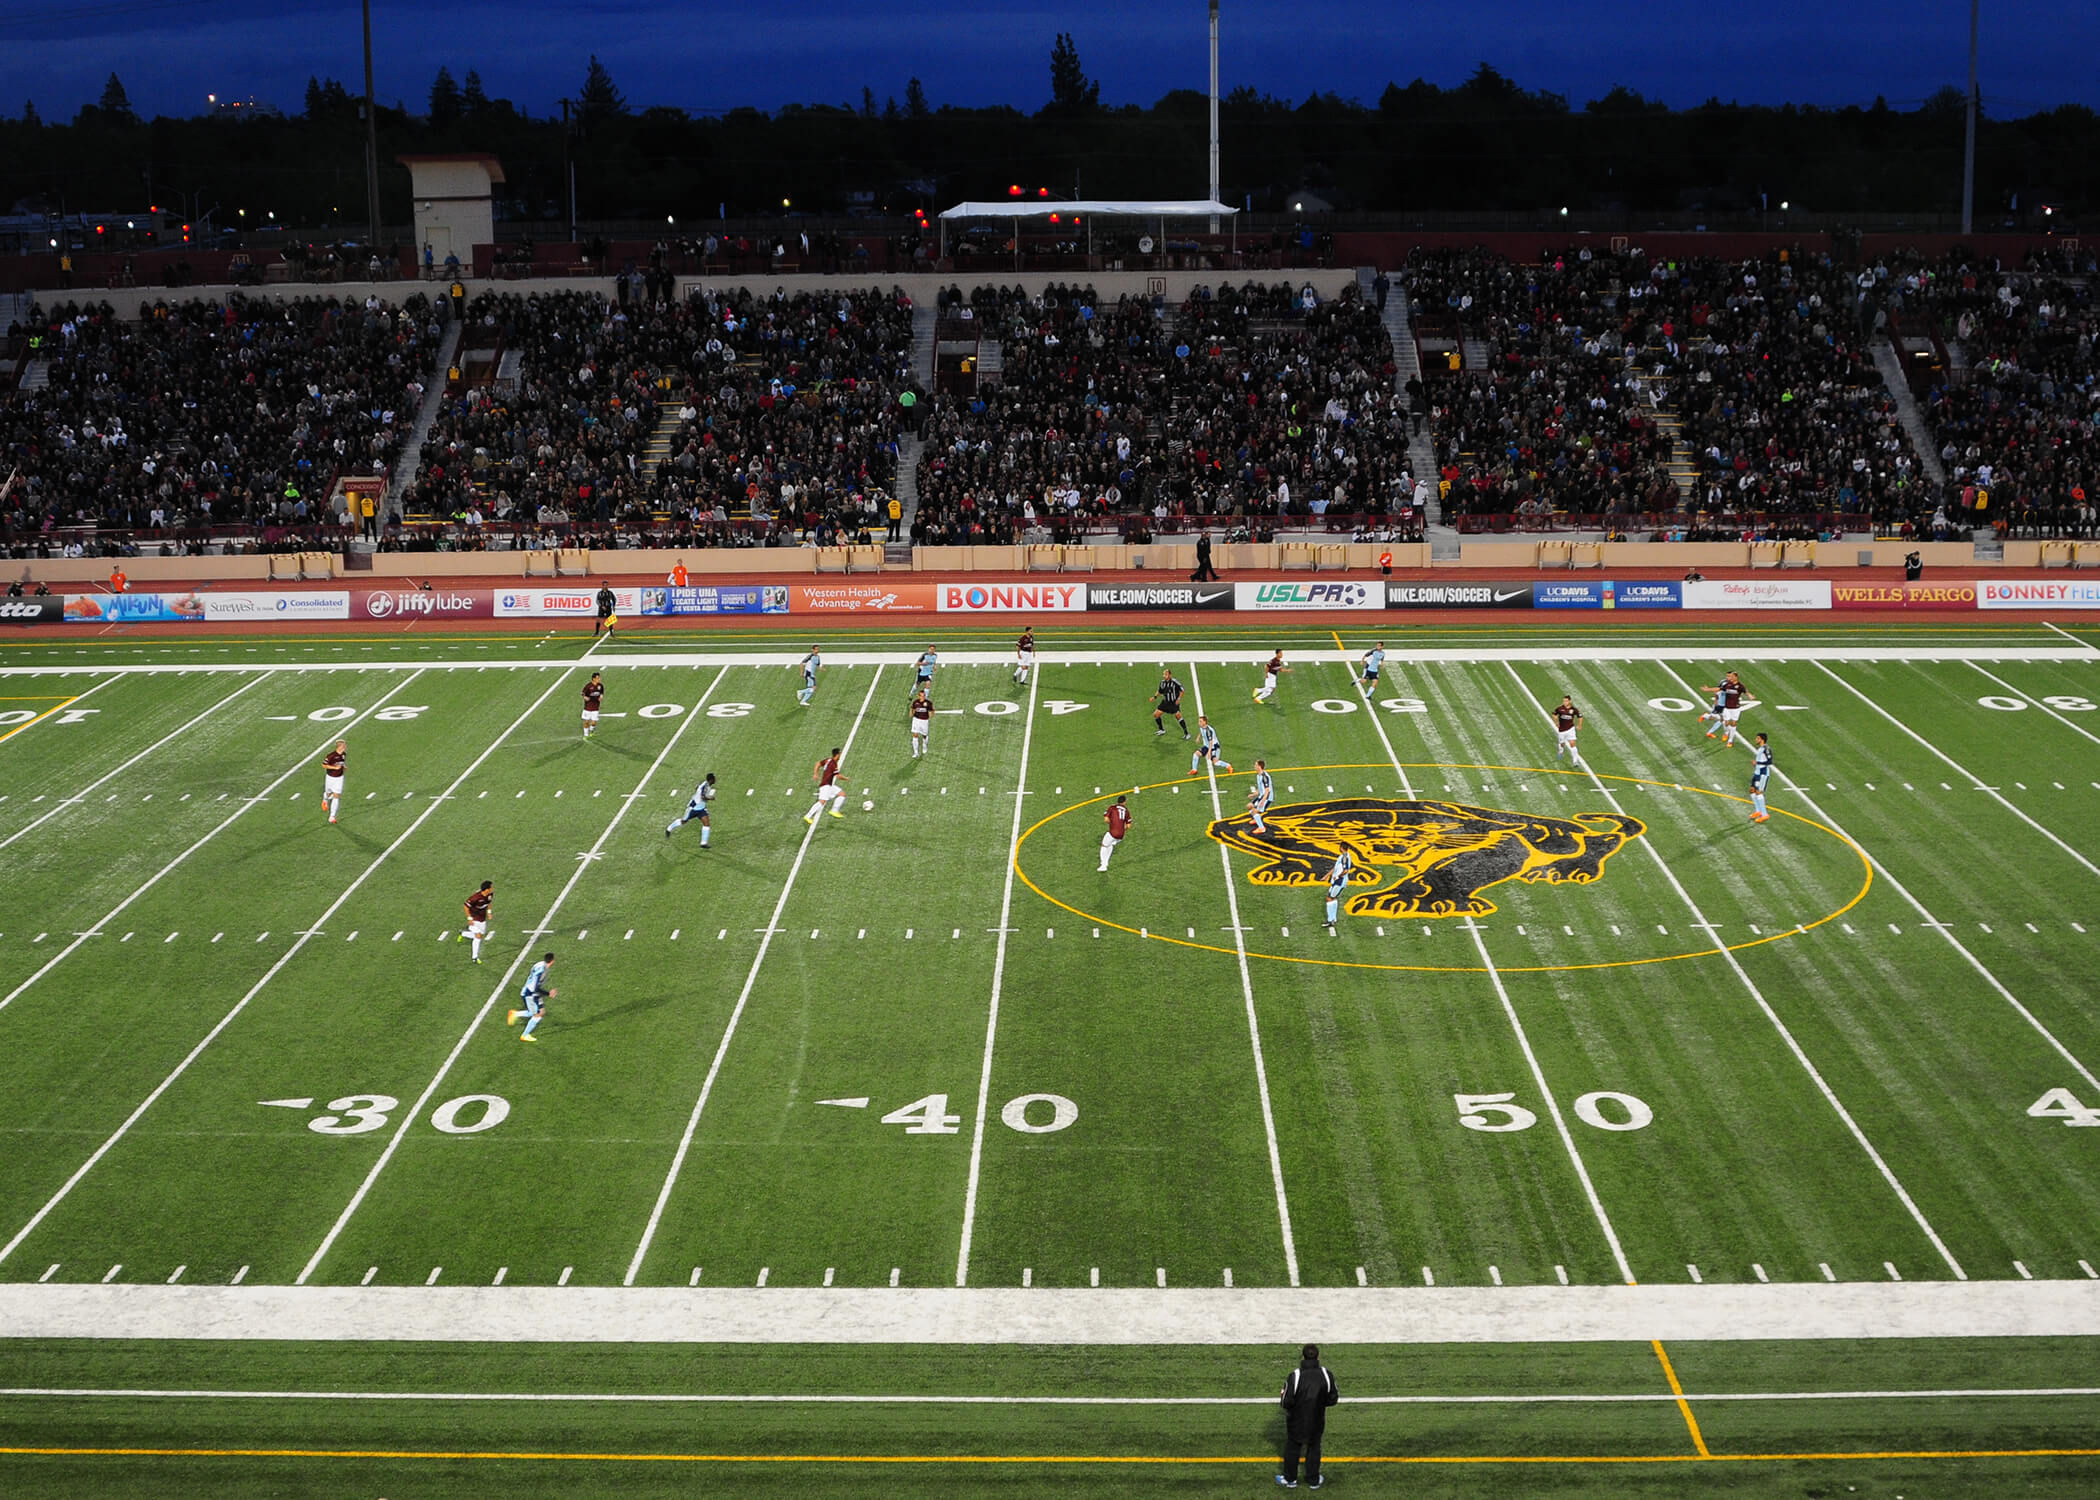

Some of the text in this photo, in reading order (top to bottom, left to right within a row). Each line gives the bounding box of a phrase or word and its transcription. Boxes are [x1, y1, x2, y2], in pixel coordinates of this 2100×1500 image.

[1152, 280, 1162, 293] 10
[803, 588, 881, 598] Western Health
[946, 586, 1076, 609] BONNEY
[1090, 588, 1193, 605] NIKE.COM/SOCCER
[1389, 587, 1492, 603] NIKE.COM/SOCCER
[1834, 588, 1975, 602] WELLS FARGO
[1986, 585, 2068, 599] BONNEY
[109, 594, 164, 616] MIKUNI
[290, 599, 343, 607] Consolidated
[395, 593, 473, 615] jiffy lube
[543, 597, 592, 609] BIMBO
[810, 598, 861, 609] Advantage
